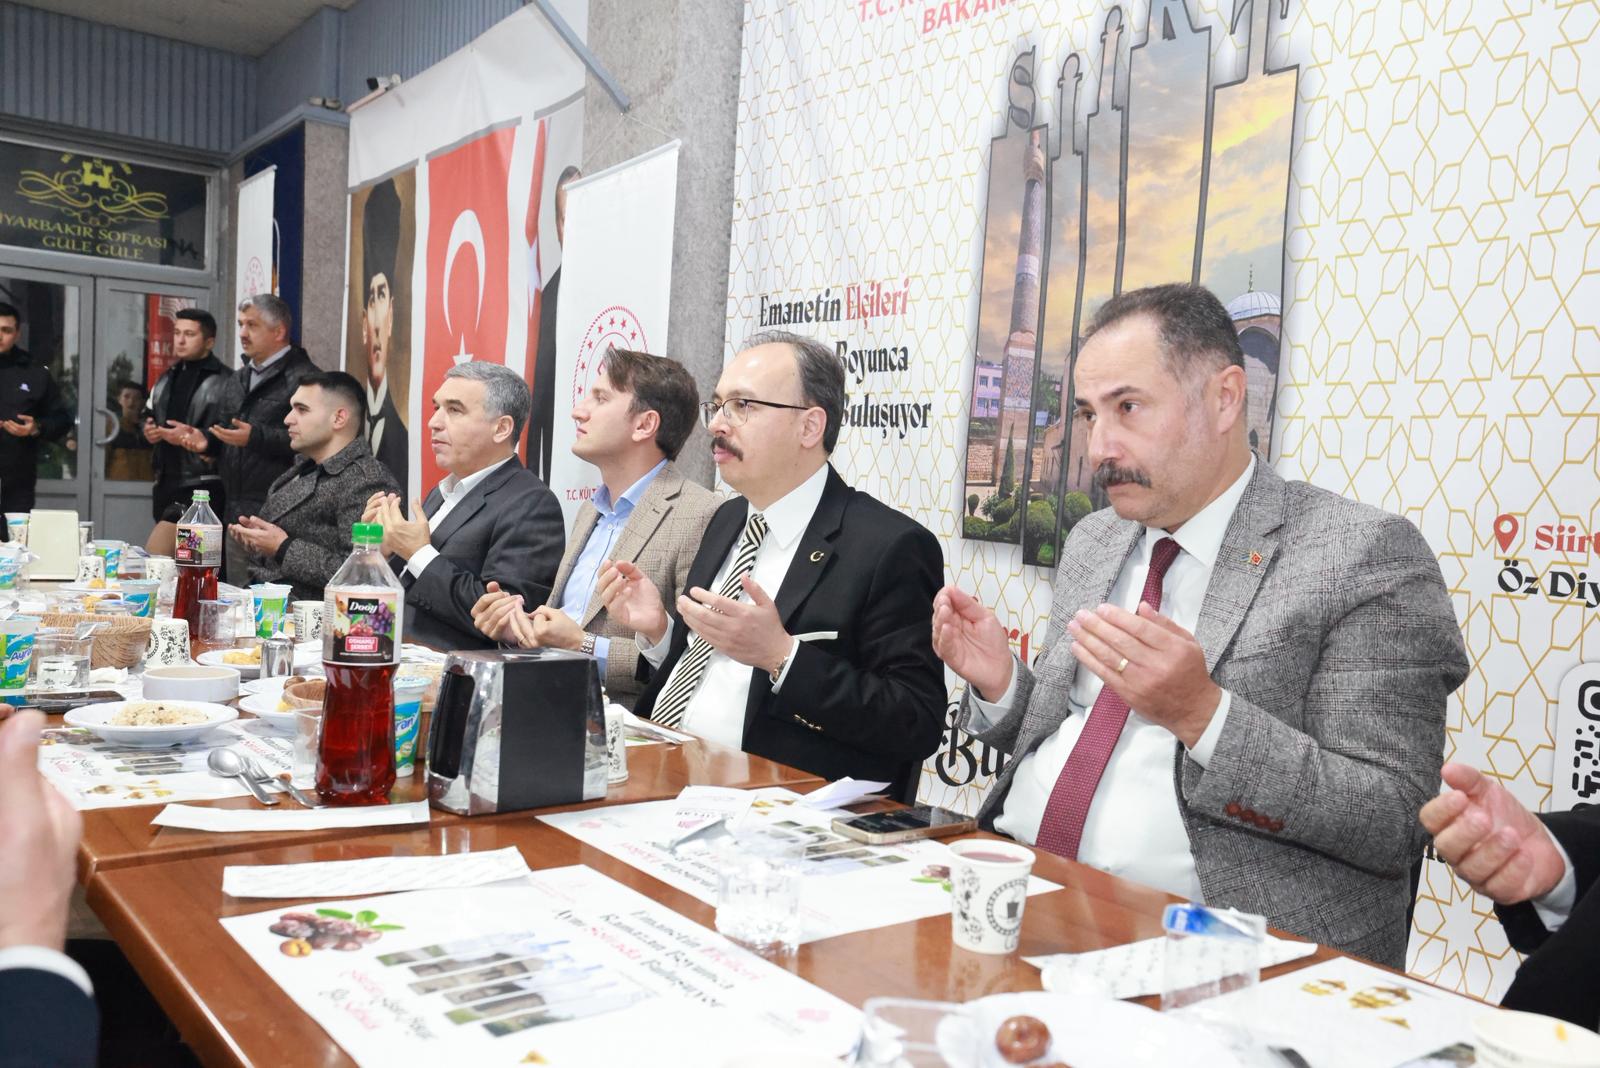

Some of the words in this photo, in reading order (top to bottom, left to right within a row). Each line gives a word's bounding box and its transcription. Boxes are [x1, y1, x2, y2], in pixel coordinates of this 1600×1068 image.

[922, 0, 1016, 34] BAKA
[759, 288, 841, 328] Emanetin
[846, 278, 910, 330] Elçileri
[836, 340, 909, 385] Boyunca
[1497, 558, 1540, 596] Öz
